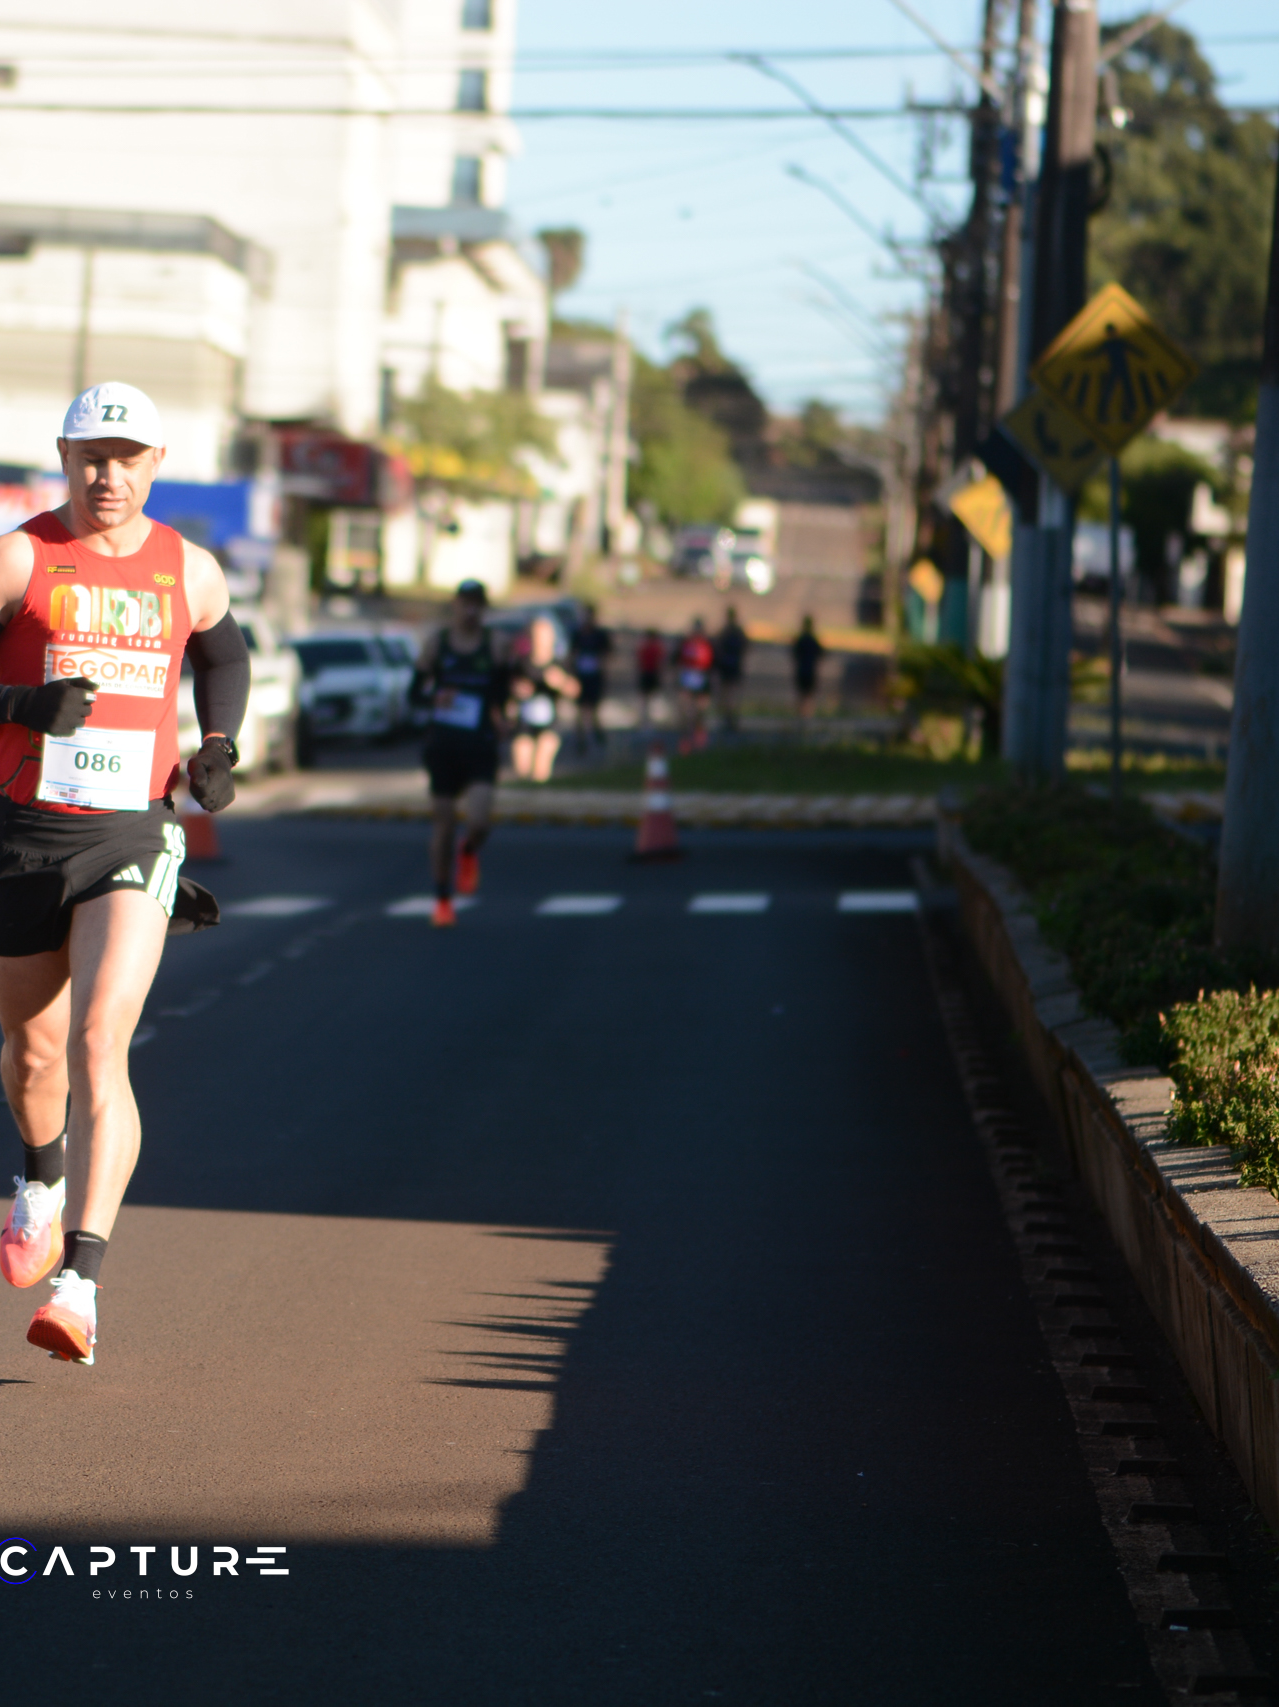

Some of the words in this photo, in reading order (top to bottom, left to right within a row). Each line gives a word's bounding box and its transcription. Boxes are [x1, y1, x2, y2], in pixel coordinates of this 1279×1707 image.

[101, 404, 128, 422] Z2
[61, 633, 118, 647] running
[128, 637, 162, 649] team
[74, 751, 122, 773] 086
